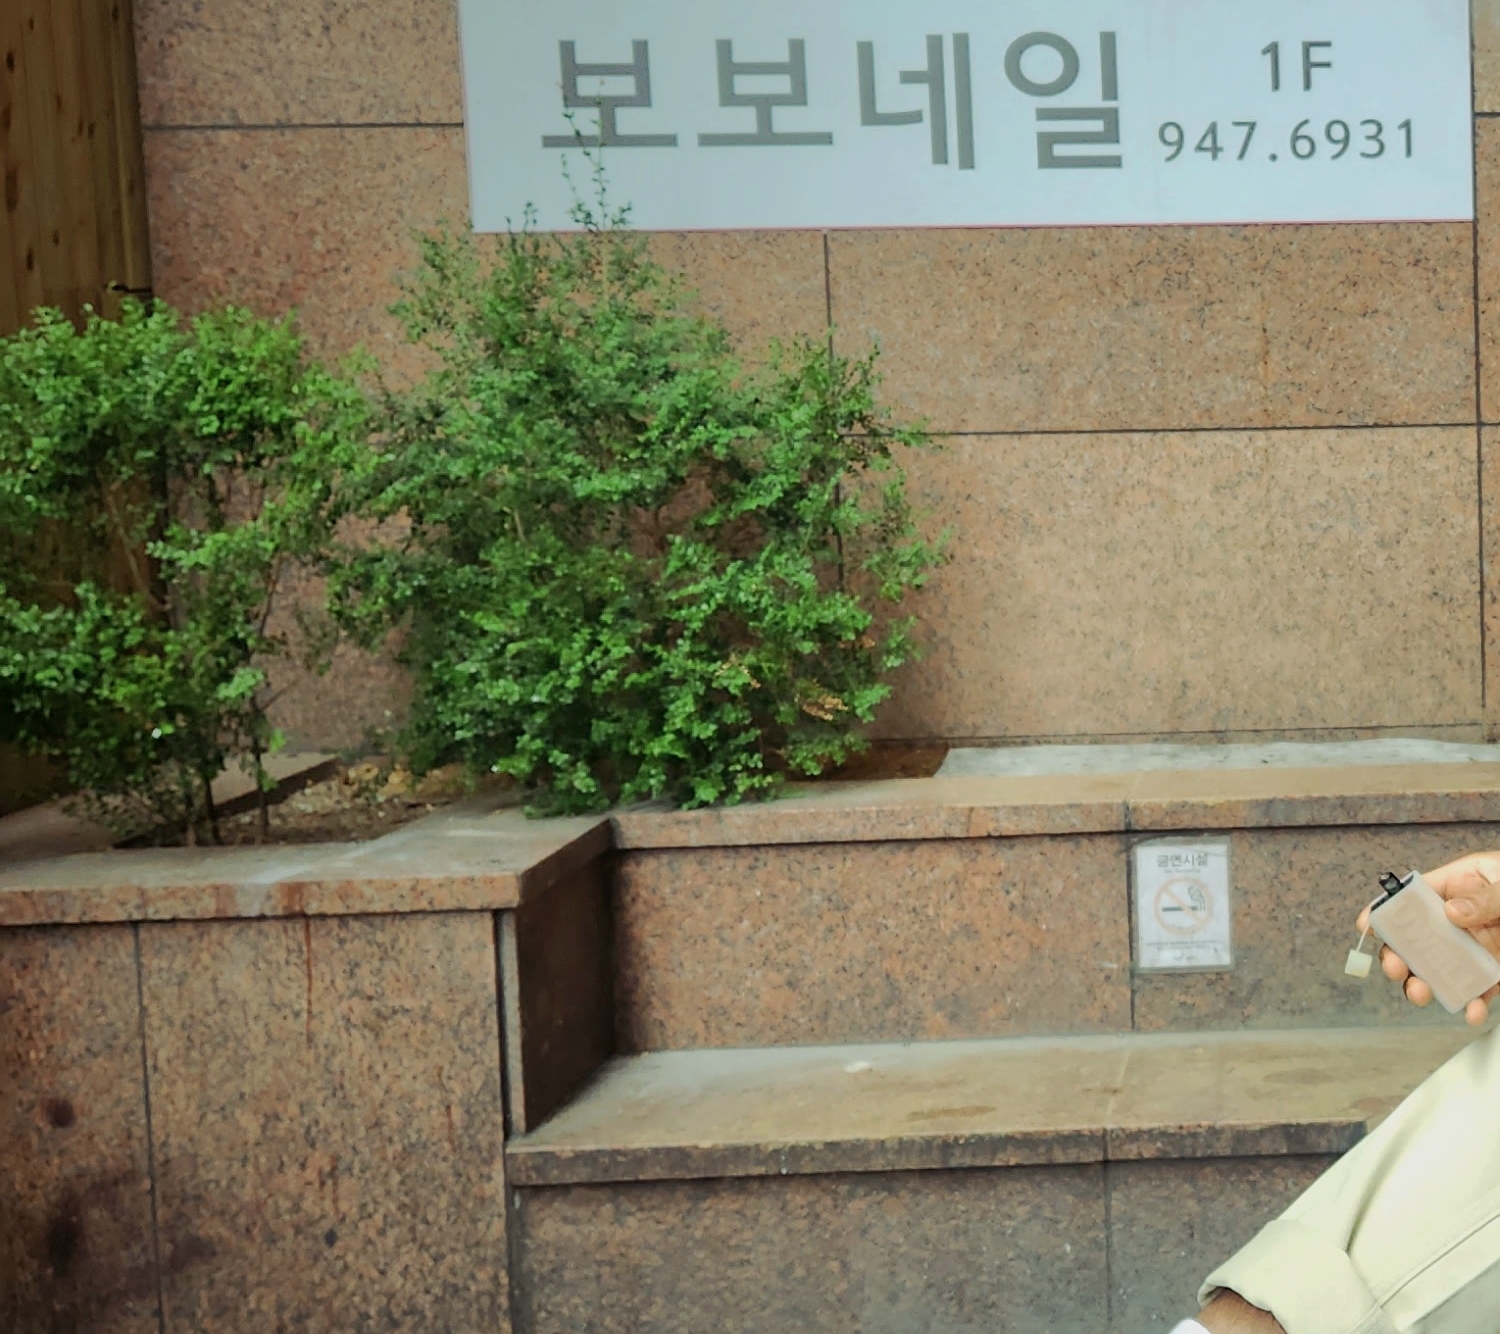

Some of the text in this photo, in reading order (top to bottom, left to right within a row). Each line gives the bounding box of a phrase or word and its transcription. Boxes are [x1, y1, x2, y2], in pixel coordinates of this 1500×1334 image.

[1259, 40, 1333, 93] 1F
[541, 30, 1124, 171] 보보네일
[1157, 119, 1416, 164] 947.6931
